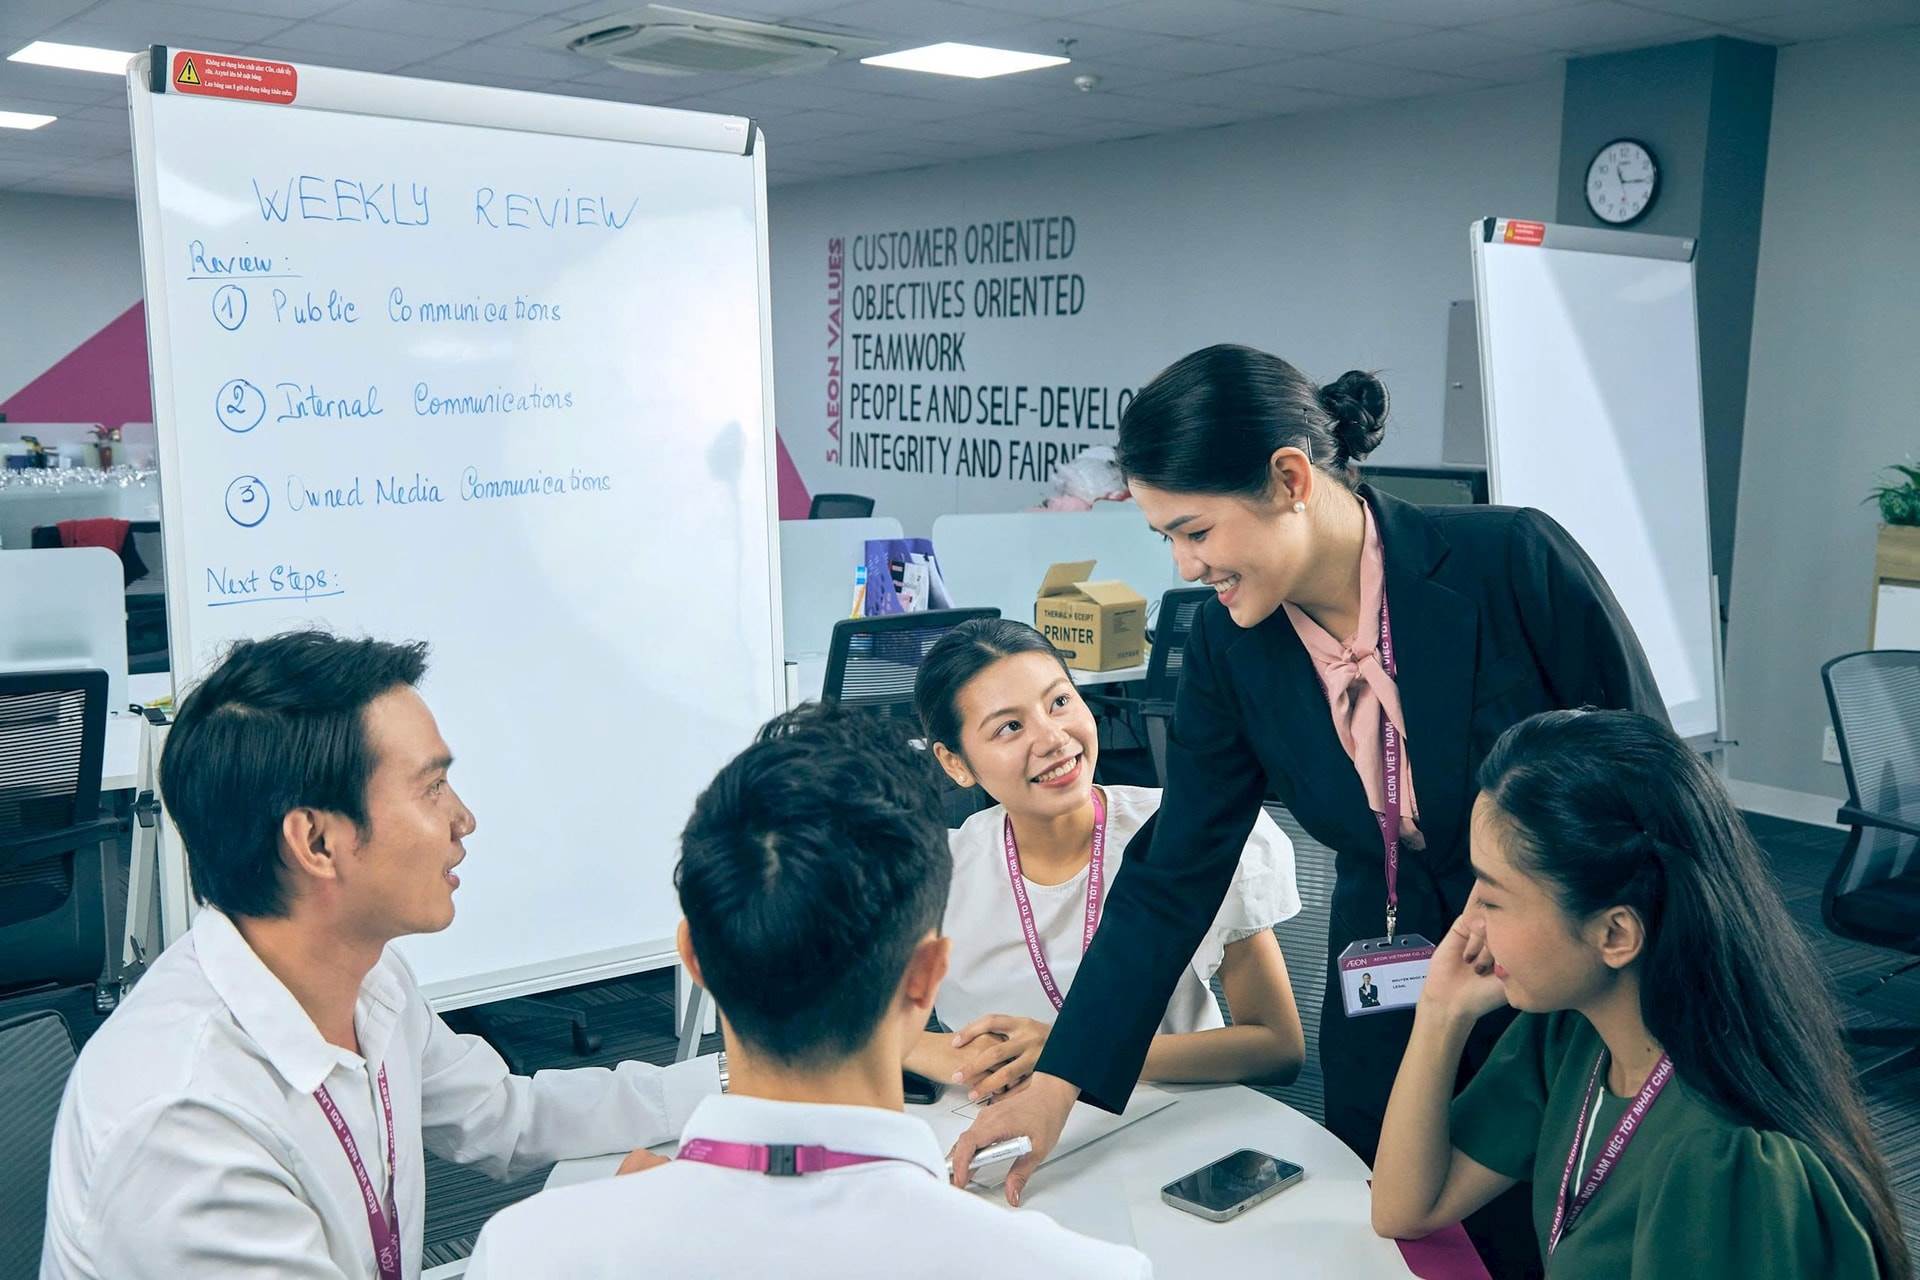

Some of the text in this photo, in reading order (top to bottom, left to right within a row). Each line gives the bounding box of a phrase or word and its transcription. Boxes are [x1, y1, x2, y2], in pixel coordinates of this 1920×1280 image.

[253, 176, 429, 225] WEEKLY
[853, 216, 1076, 271] CUSTOMER ORIENTED
[273, 288, 359, 324] Public
[388, 287, 561, 323] Communications
[852, 274, 1085, 320] OBJECTIVES ORIENTED
[826, 237, 842, 463] 5 AEON VALUES
[852, 332, 966, 371] TEAMWORK
[276, 383, 384, 423] Internal
[414, 382, 573, 416] Communications
[850, 383, 1141, 430] PEOPLE AND SELF-DEVELO
[850, 432, 1090, 482] INTEGRITY AND FAIRN
[287, 474, 364, 512] Owned
[376, 473, 445, 505] Media
[461, 465, 612, 501] Communications
[207, 567, 260, 595] Next
[1068, 611, 1094, 622] ECEIPT
[1044, 624, 1094, 645] PRINTER
[1384, 722, 1395, 747] NAM
[1388, 776, 1397, 805] AEON
[1007, 847, 1016, 857] IN
[1010, 858, 1019, 876] FOR
[1014, 877, 1027, 904] WORK
[1022, 904, 1030, 916] TO
[1025, 917, 1044, 968] COMPANIES
[1040, 970, 1054, 991] BEST
[344, 1134, 359, 1162] NAM
[364, 1185, 379, 1215] AEON
